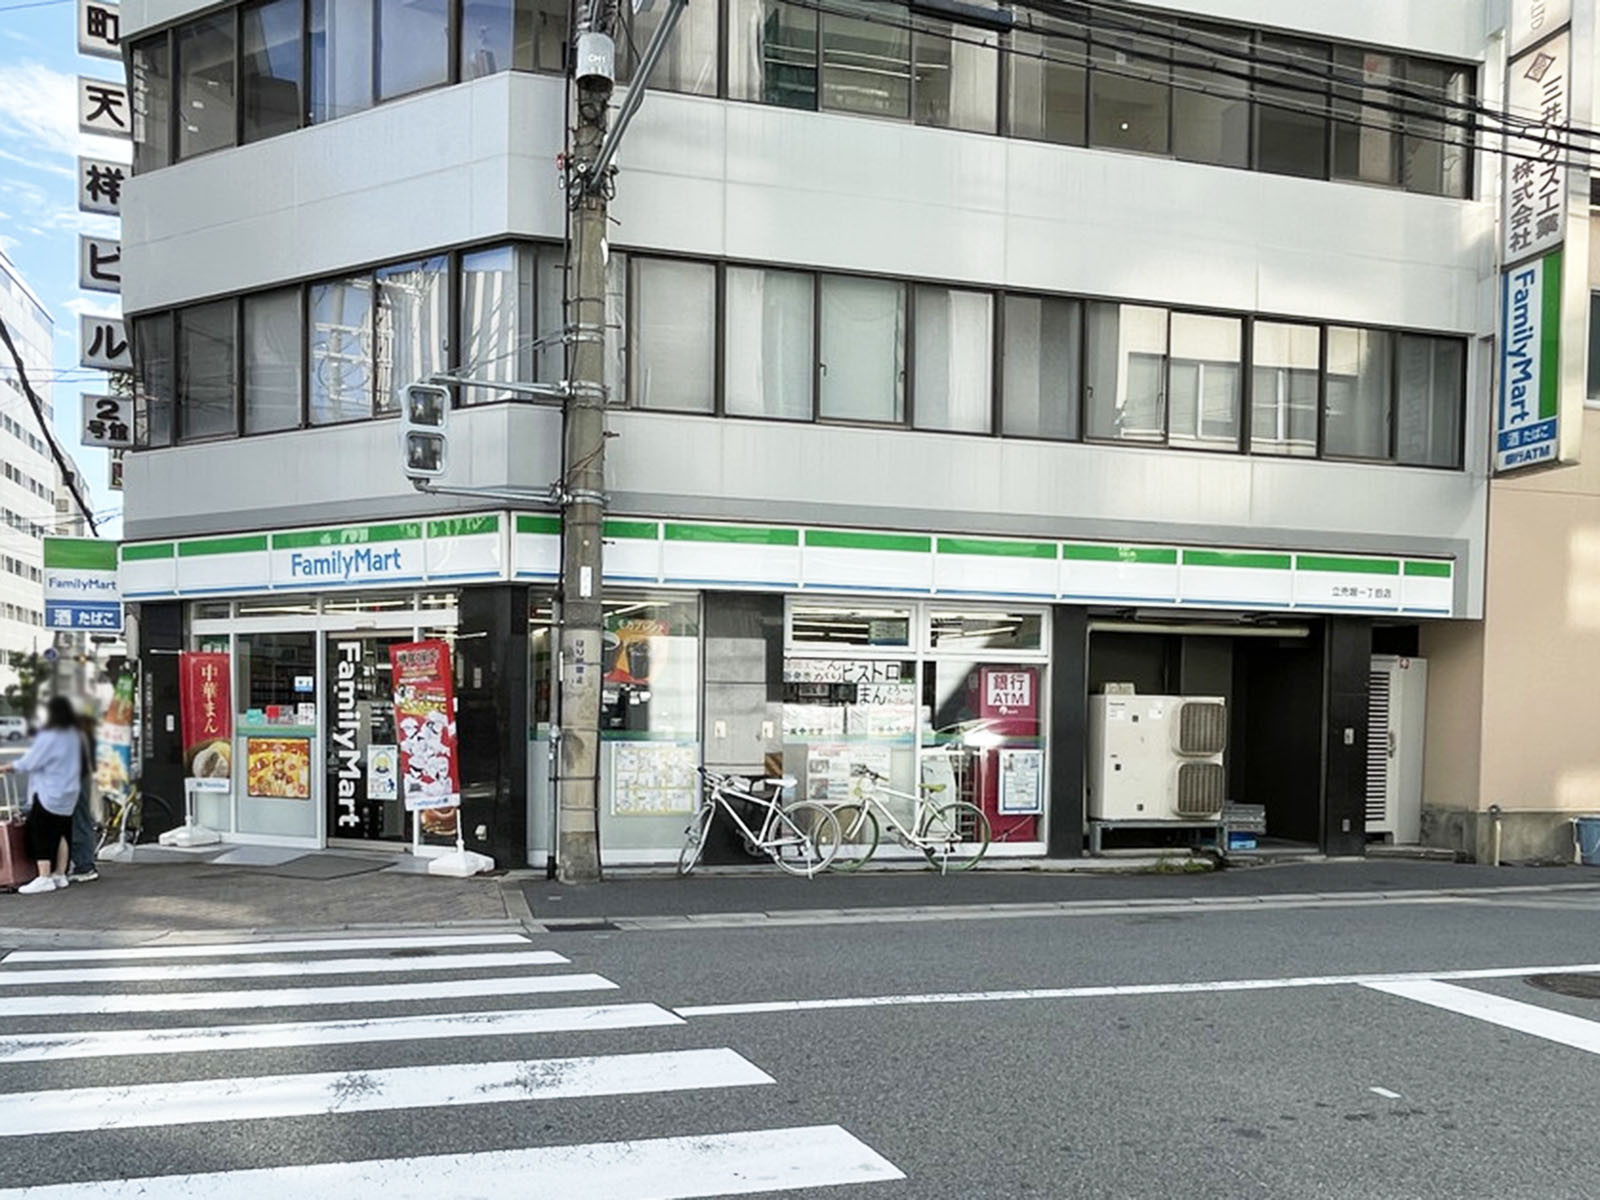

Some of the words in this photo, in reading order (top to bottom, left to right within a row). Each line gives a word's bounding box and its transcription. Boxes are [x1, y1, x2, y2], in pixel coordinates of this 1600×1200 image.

[1508, 159, 1534, 253] 株式会社
[1507, 268, 1535, 425] FamilyMart
[290, 548, 402, 580] FamilyMart
[48, 576, 117, 591] FamilyMart
[53, 608, 72, 626] 酒
[78, 610, 115, 626] たばこ
[842, 661, 900, 682] ビストロ
[993, 674, 1025, 691] 銀行
[202, 663, 219, 734] 中華まん
[858, 684, 887, 705] まん
[993, 693, 1025, 704] ATM
[333, 641, 361, 828] FamilyMart
